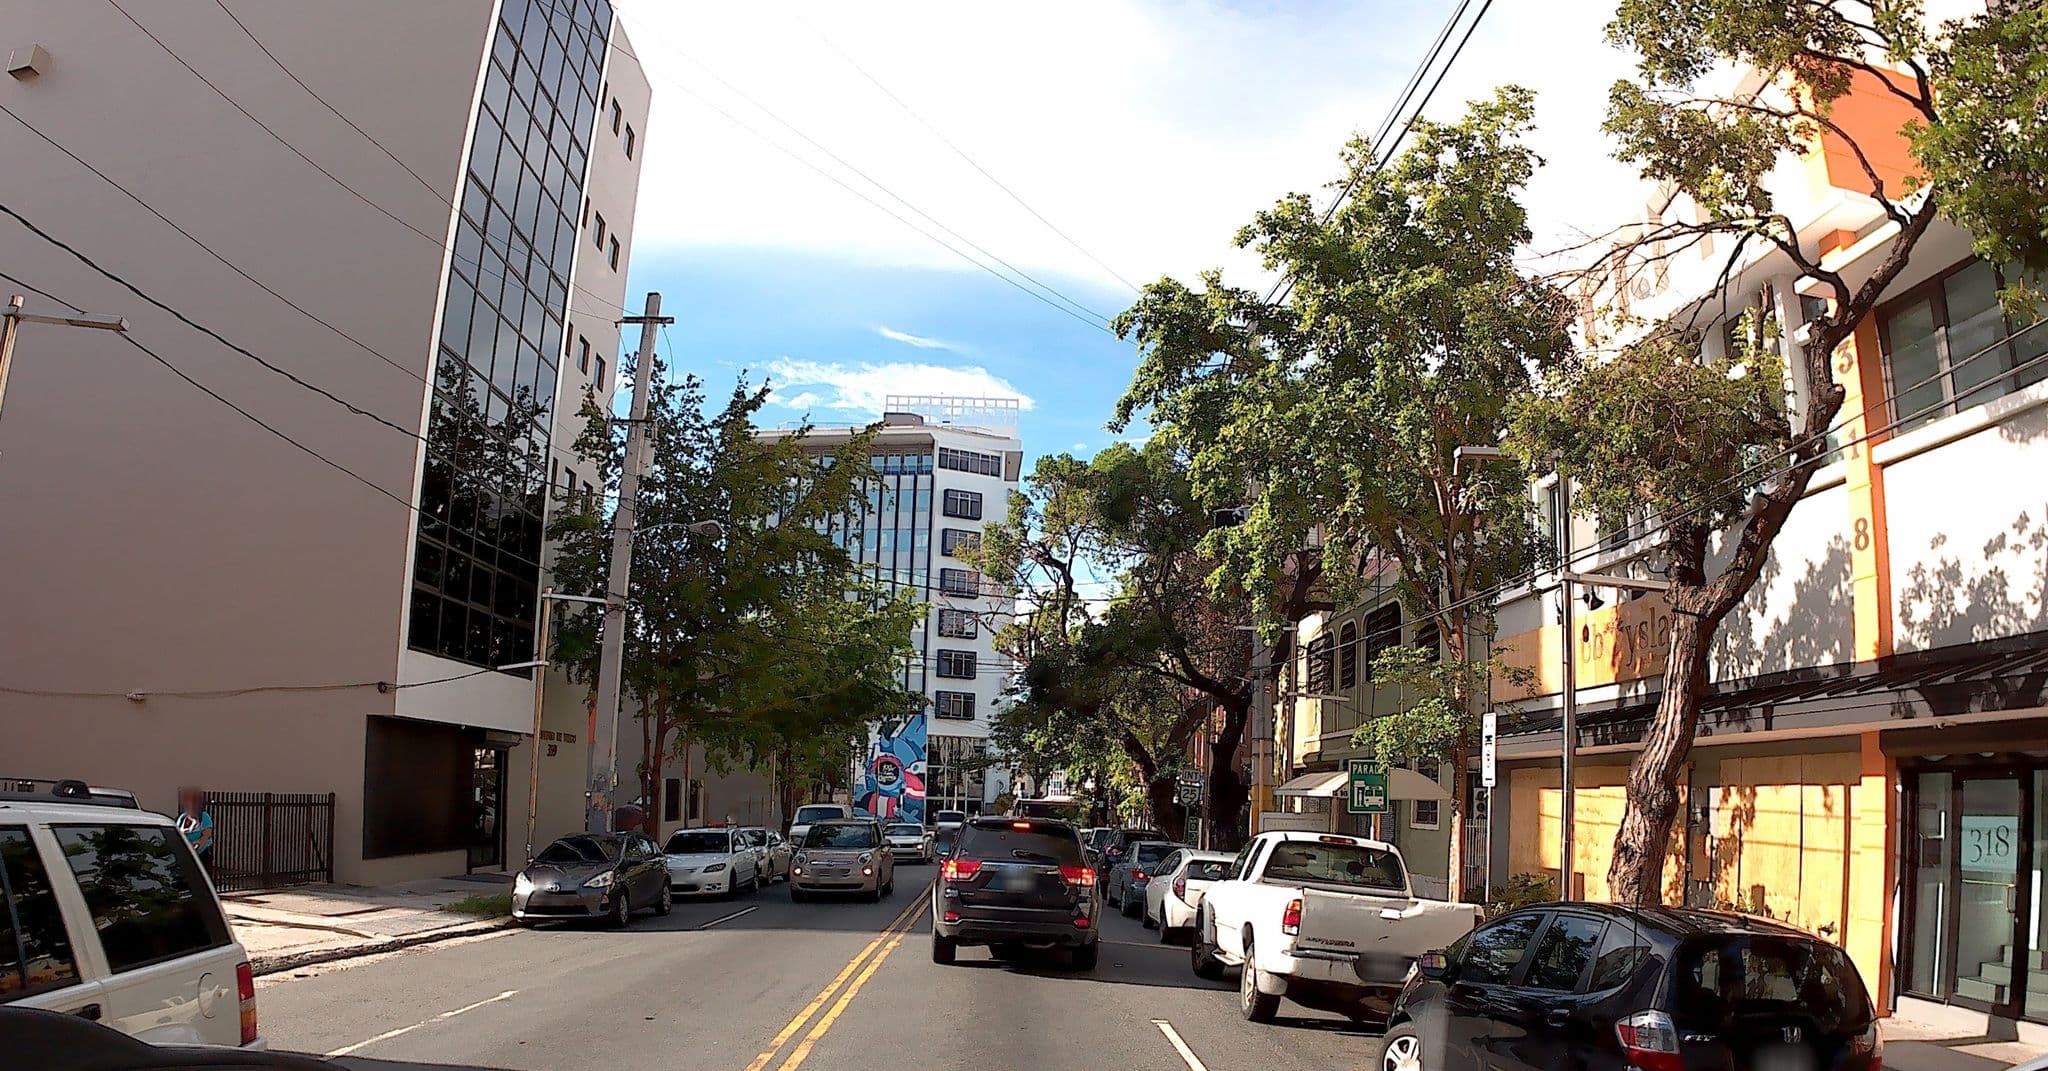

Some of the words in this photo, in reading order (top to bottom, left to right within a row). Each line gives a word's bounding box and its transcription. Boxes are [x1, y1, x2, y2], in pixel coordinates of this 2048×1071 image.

[1352, 764, 1387, 774] PARAD
[1184, 771, 1199, 780] INT
[1182, 788, 1197, 799] 25
[1970, 825, 2010, 863] 318
